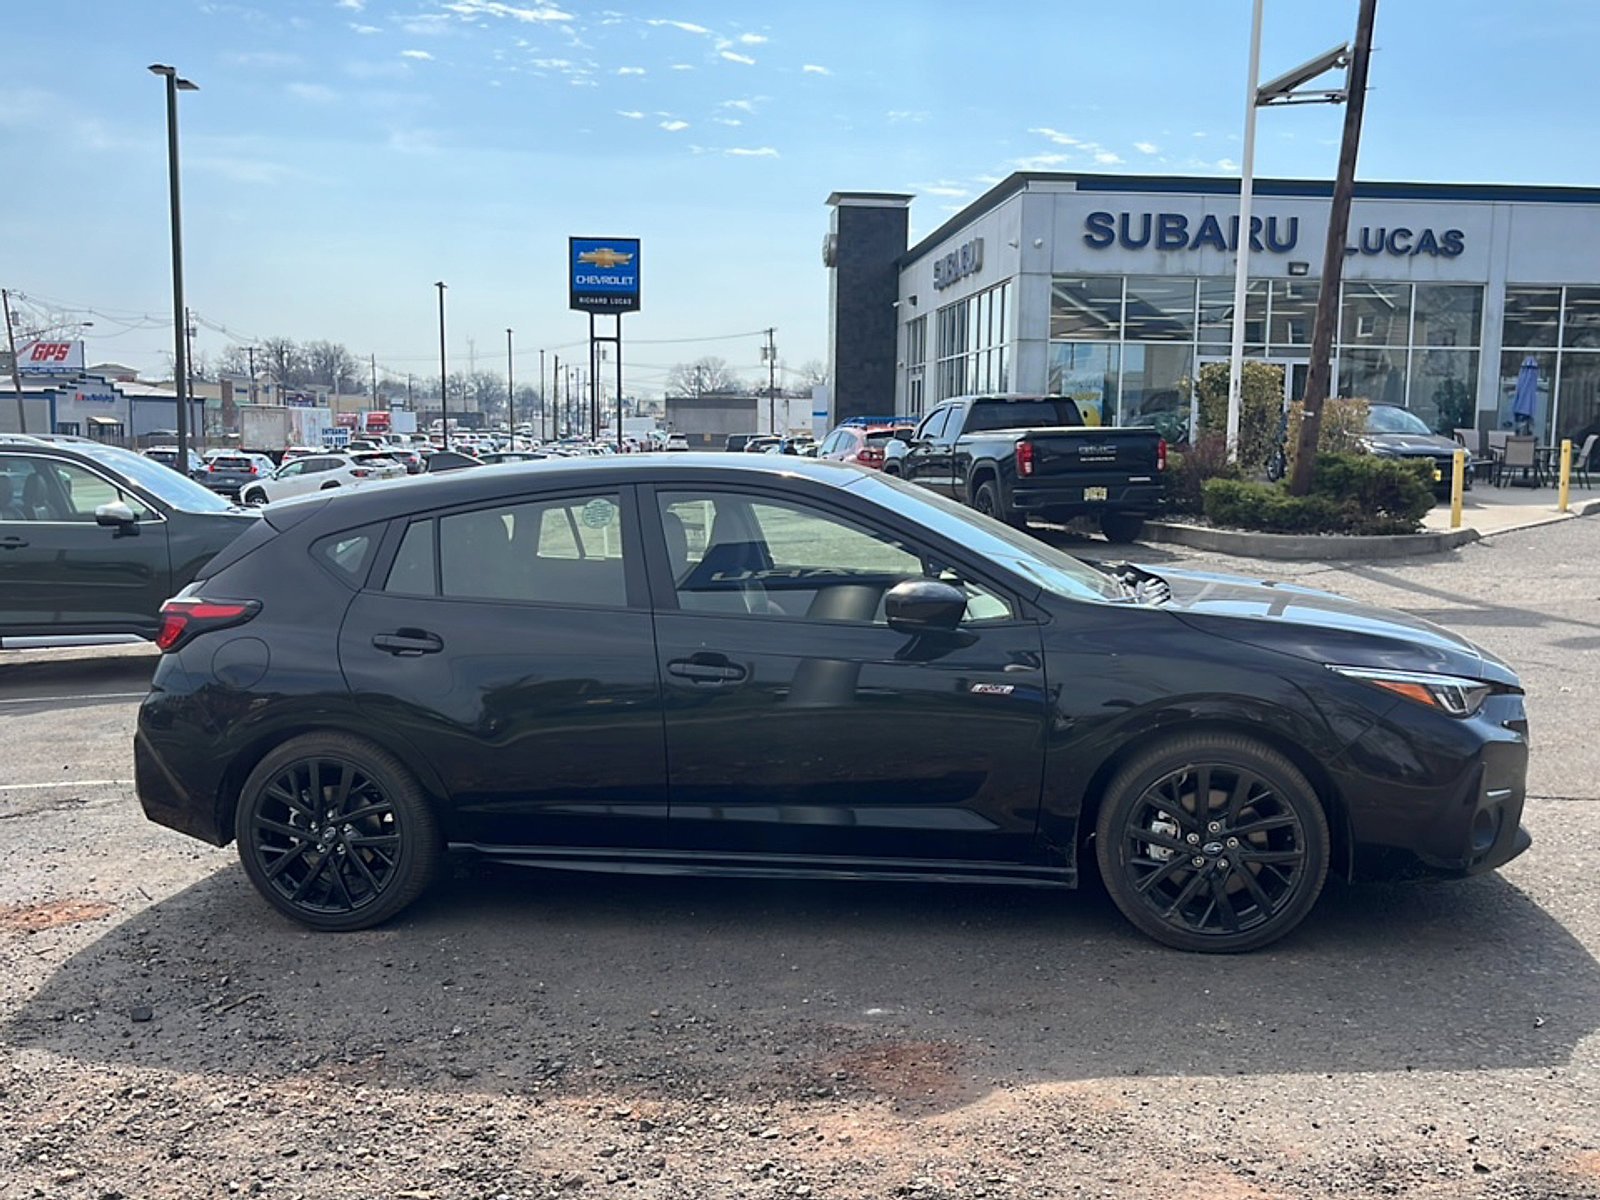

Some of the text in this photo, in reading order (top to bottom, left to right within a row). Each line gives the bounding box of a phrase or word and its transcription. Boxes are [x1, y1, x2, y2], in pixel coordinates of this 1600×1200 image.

[1083, 212, 1299, 252] SUBARU
[576, 275, 634, 285] CHEVROLET
[579, 296, 608, 305] RICHARD
[31, 343, 71, 361] GPS
